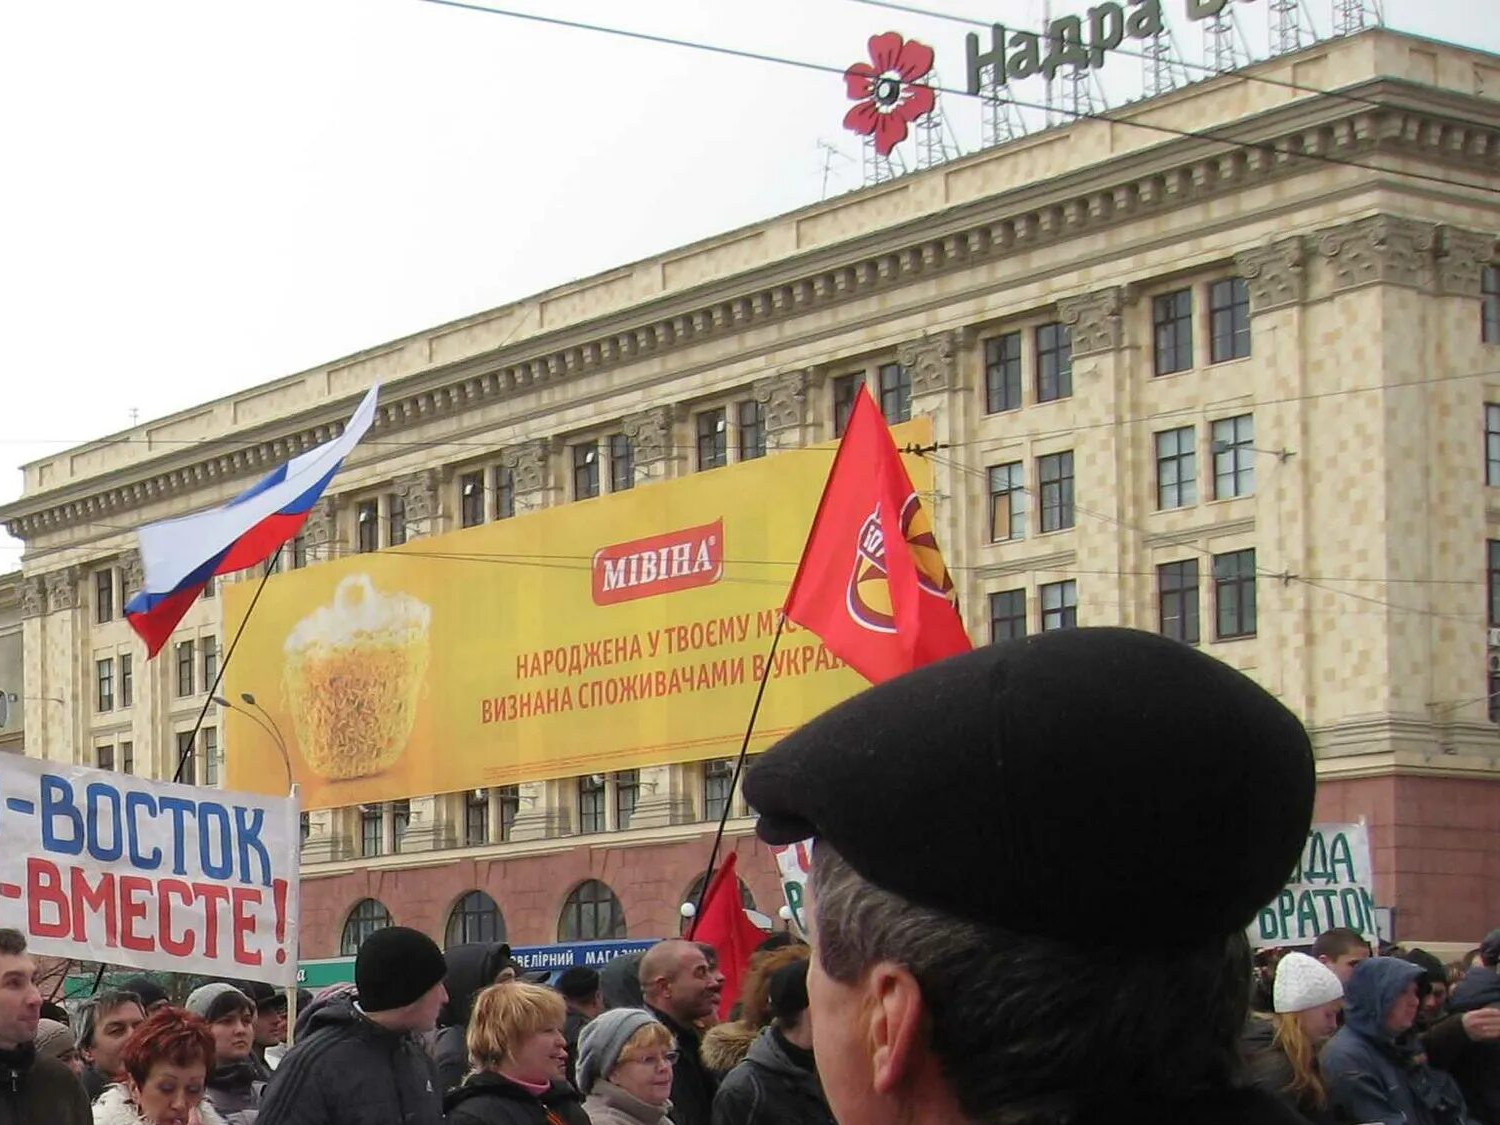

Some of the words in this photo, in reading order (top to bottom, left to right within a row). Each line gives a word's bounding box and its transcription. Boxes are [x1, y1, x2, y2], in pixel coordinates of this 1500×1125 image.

[966, 0, 1164, 95] Надра
[602, 538, 712, 592] МІВІНА
[516, 633, 642, 680] НАРОДЖЕНА
[647, 630, 661, 658] У
[665, 612, 750, 654] ТВОЄМУ
[482, 685, 573, 724] ВИЗНАНА
[578, 656, 744, 709] СПОЖИВАЧАМИ
[753, 654, 765, 682] В
[773, 643, 847, 679] УКРА
[1290, 831, 1357, 885] ДА
